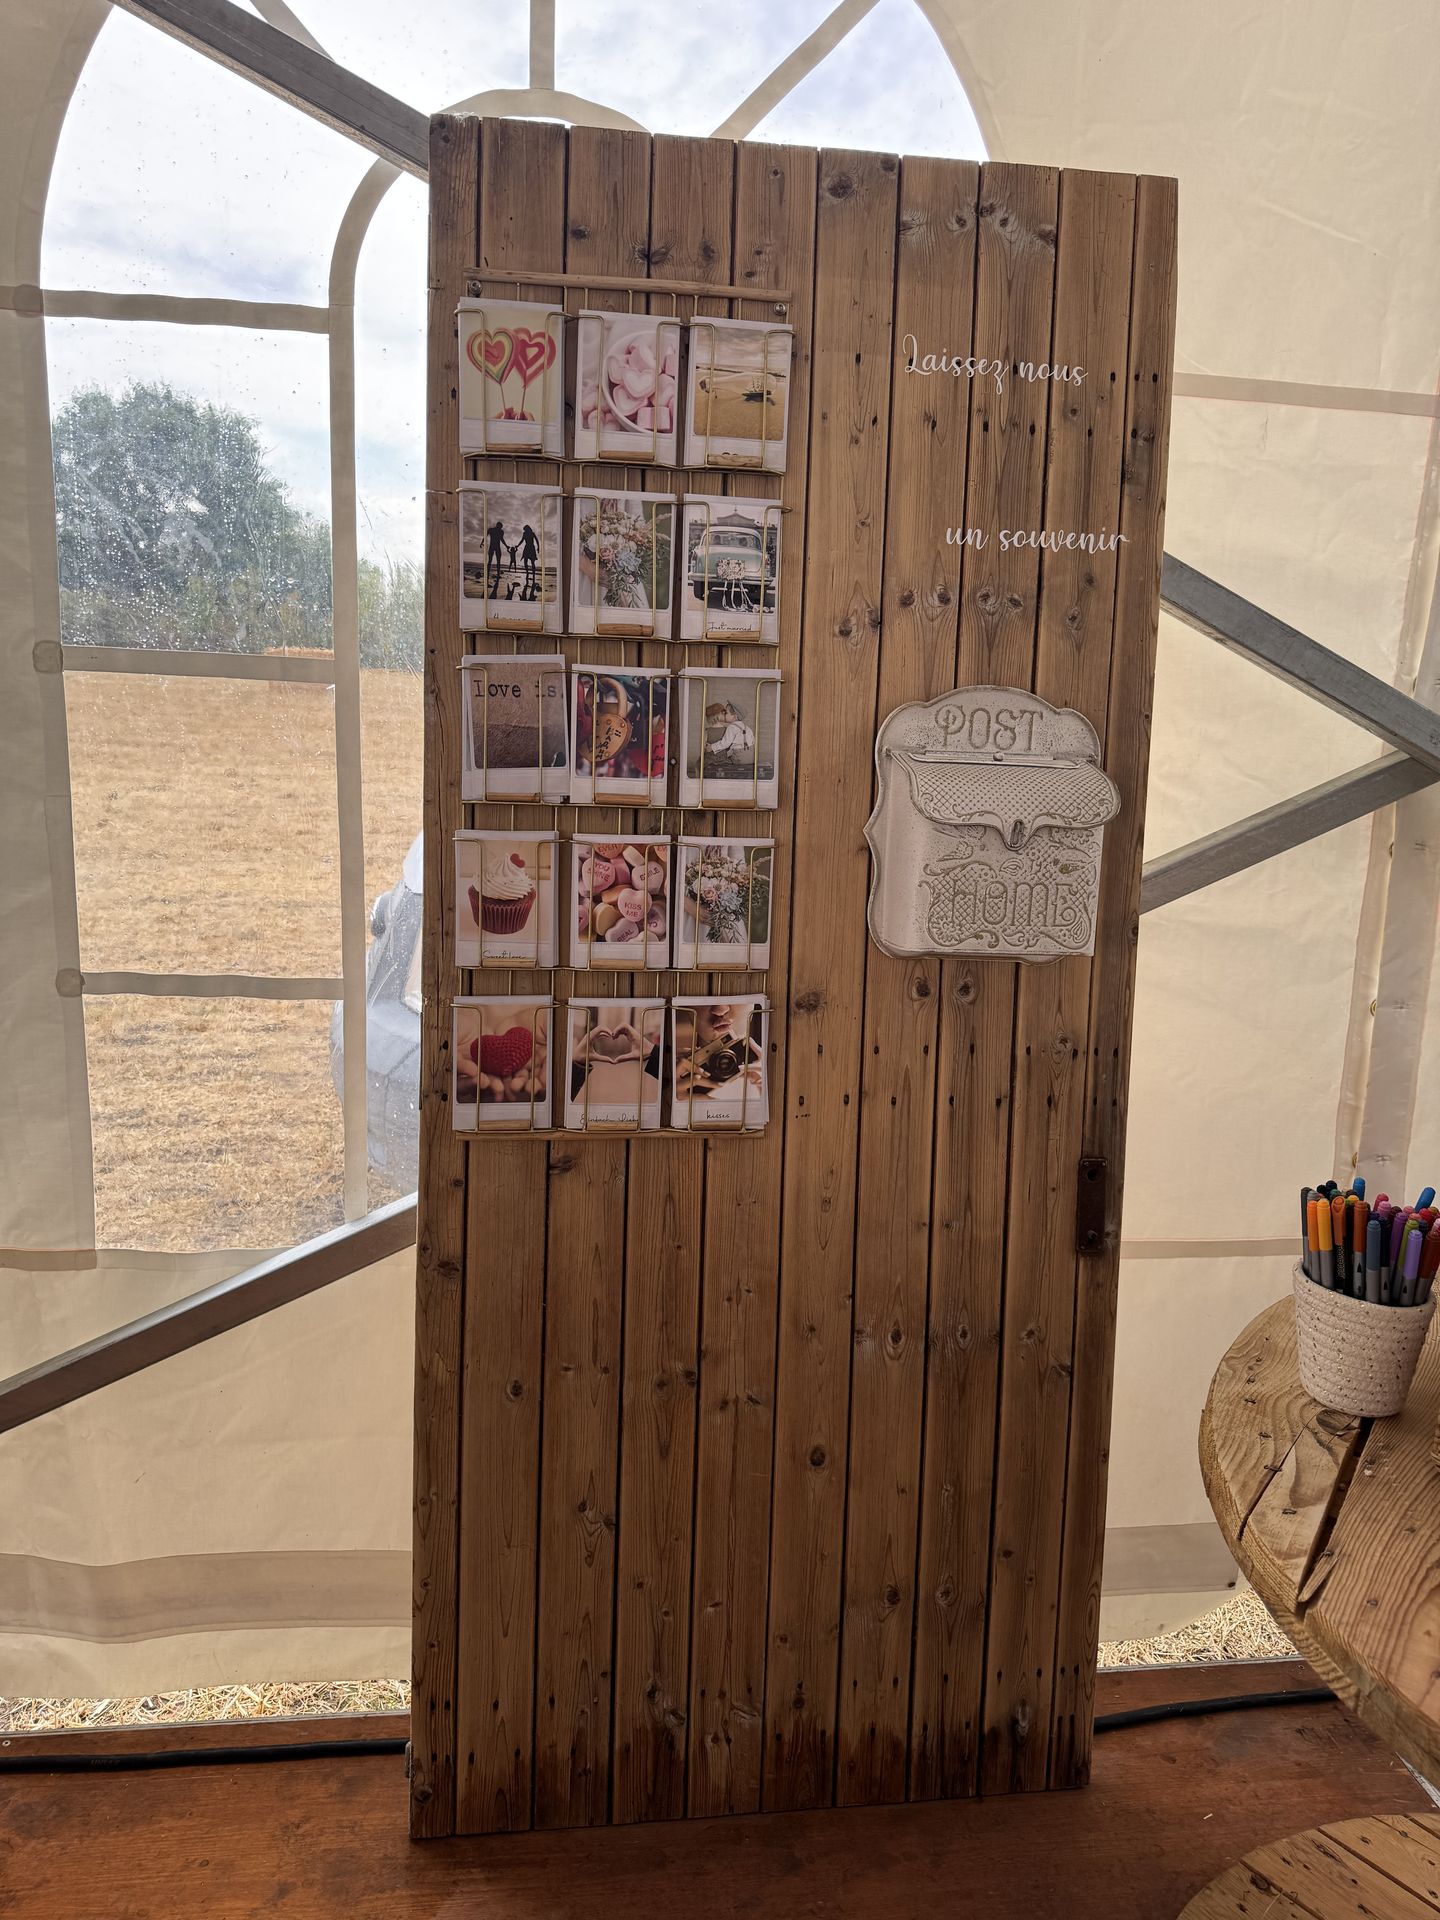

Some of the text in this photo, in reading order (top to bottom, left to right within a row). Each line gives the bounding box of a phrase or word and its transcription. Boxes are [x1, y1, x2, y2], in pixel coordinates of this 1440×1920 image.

[902, 333, 1089, 395] Laissez nous
[945, 525, 1130, 554] un souvenir
[473, 679, 522, 698] love
[934, 703, 1044, 752] POST
[595, 862, 610, 872] YOU
[624, 902, 642, 911] KISS
[949, 880, 1079, 928] HOME
[626, 910, 639, 918] ME
[706, 1109, 731, 1120] kisses
